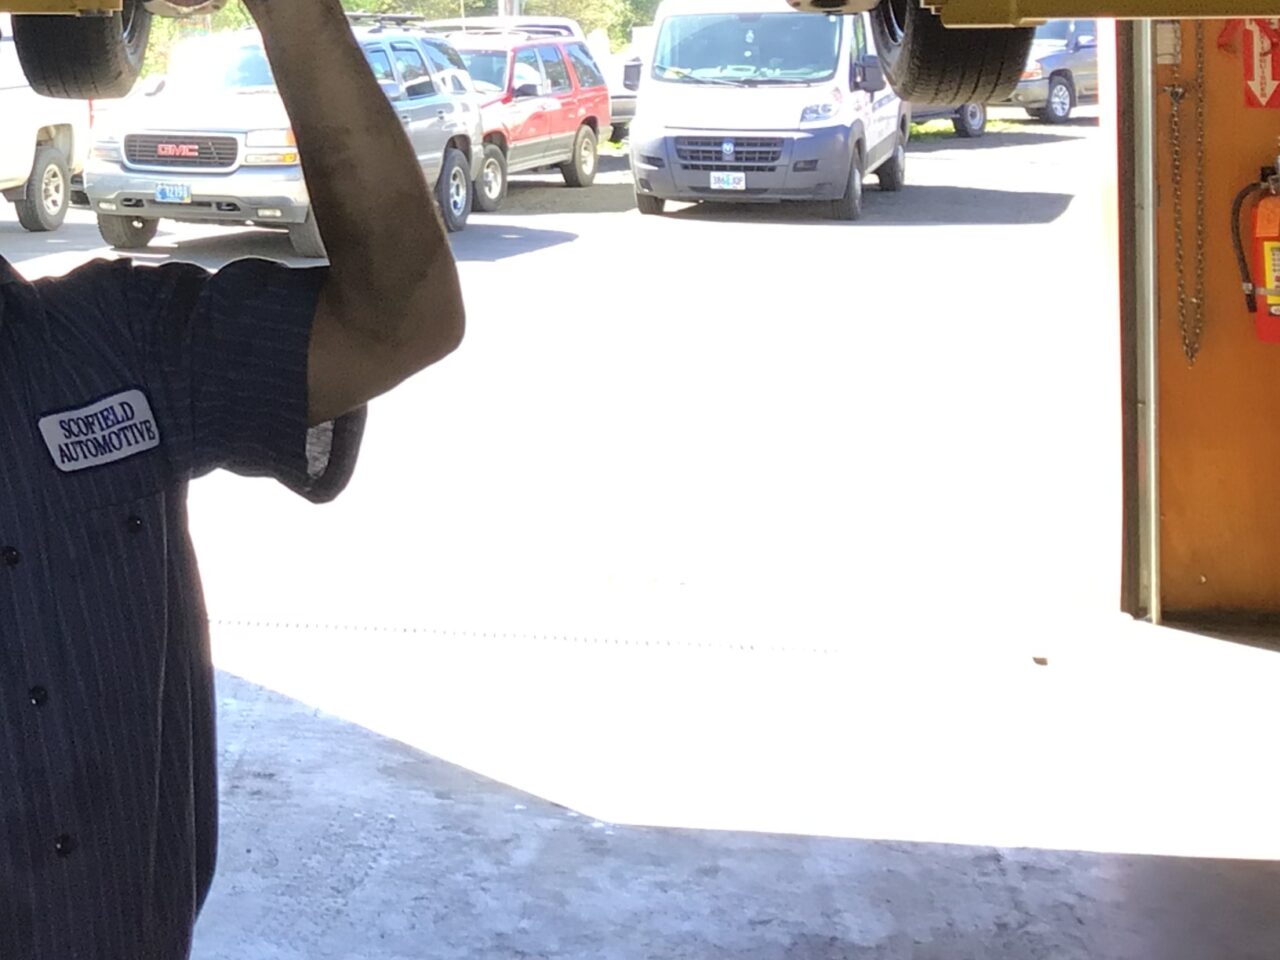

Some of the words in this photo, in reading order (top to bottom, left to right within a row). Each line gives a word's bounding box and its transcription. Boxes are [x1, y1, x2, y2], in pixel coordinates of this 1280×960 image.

[157, 144, 199, 156] GMC
[58, 400, 135, 439] SCOFIELD
[57, 419, 156, 464] AUTOMOTIVE
